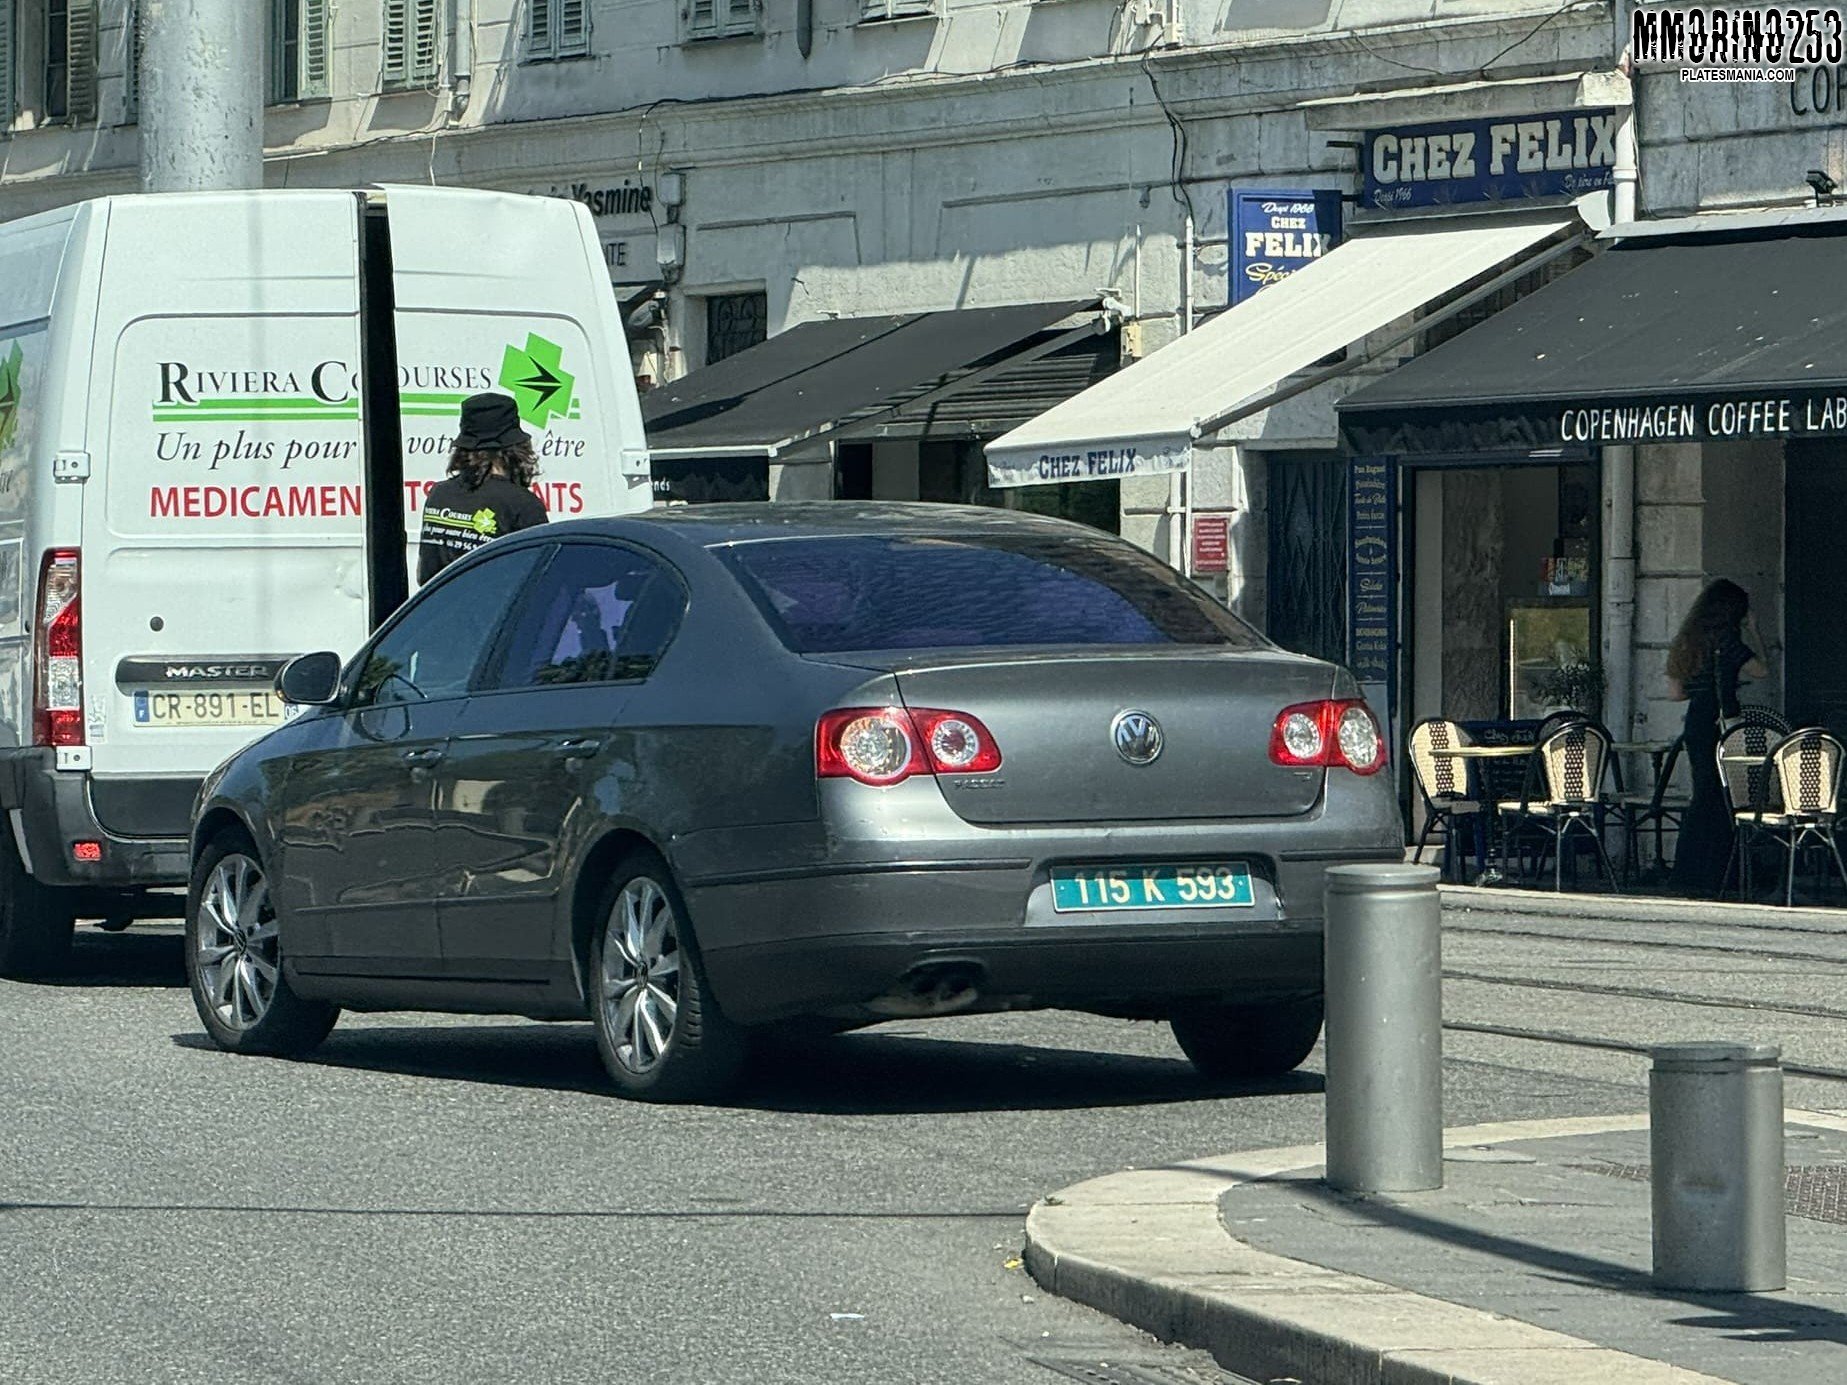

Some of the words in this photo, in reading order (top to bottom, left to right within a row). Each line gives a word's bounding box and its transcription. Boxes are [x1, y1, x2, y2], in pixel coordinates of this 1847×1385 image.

[1373, 132, 1476, 184] CHEZ
[1489, 115, 1616, 175] FELIX
[1271, 216, 1306, 229] CHEZ
[1245, 232, 1331, 258] FELIX
[156, 362, 301, 403] RIVIERA
[1561, 405, 1695, 442] COPENHAGEN
[1708, 400, 1791, 436] COFFEE
[1806, 397, 1847, 431] LAB
[156, 432, 201, 461] Un
[208, 430, 276, 470] plus
[280, 438, 358, 470] pour
[1039, 455, 1081, 479] CHEZ
[1087, 448, 1137, 475] FELIX
[165, 665, 269, 678] MASTER
[152, 692, 279, 719] CR-891-EL
[1075, 869, 1130, 905] 115
[1142, 867, 1166, 902] K
[1176, 866, 1236, 901] 593
